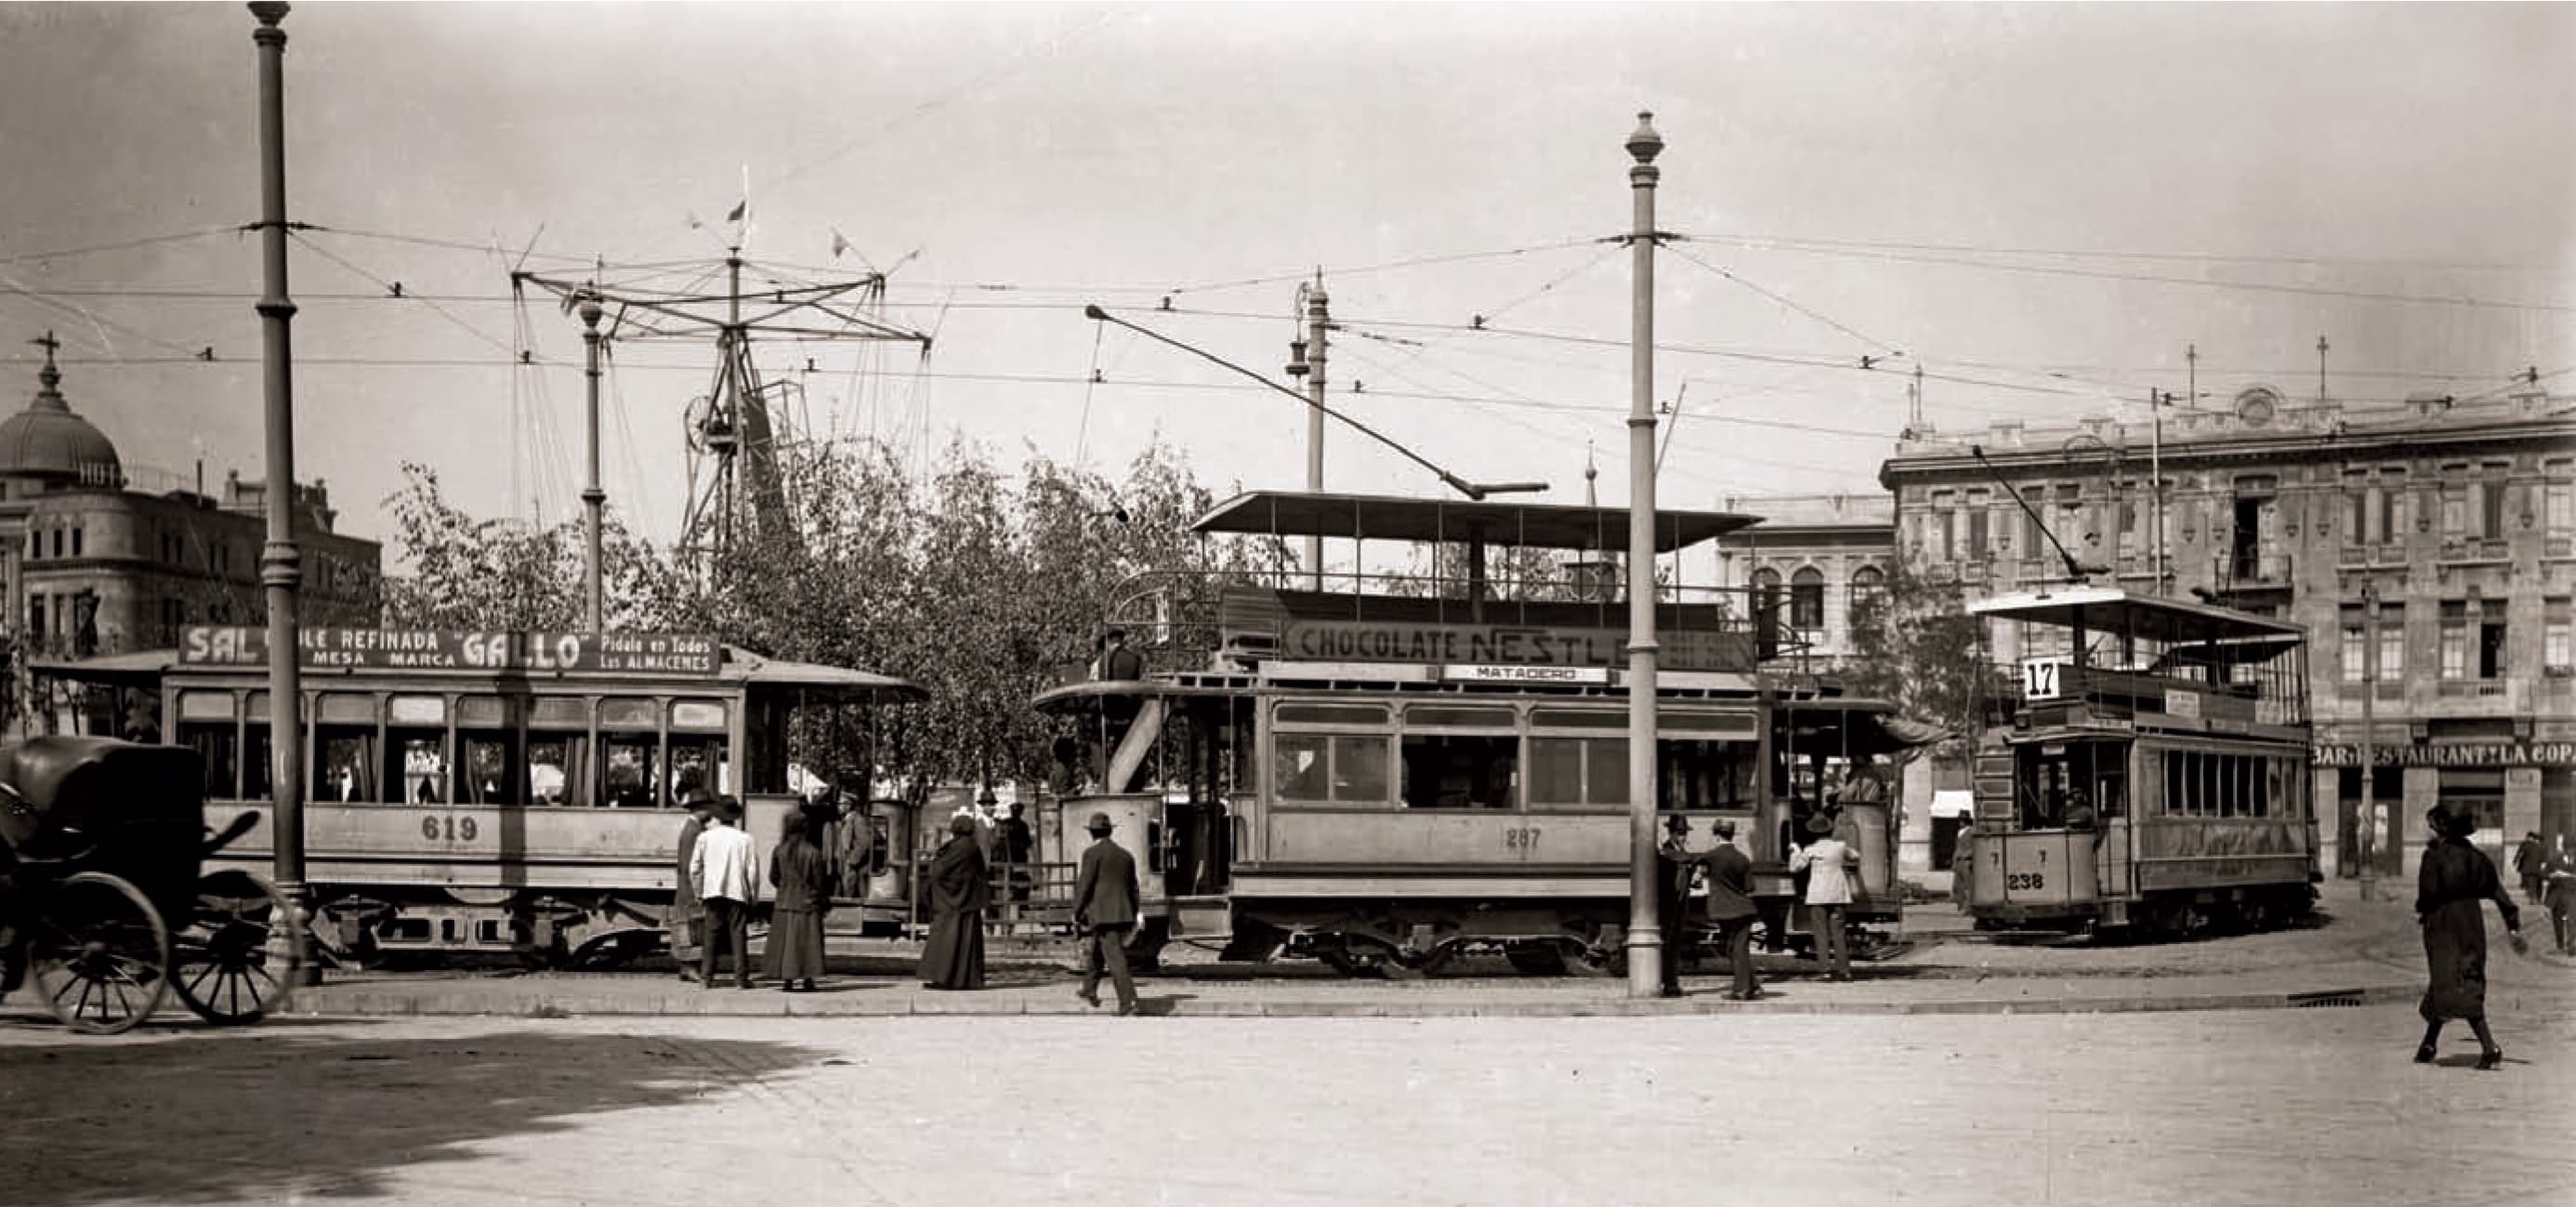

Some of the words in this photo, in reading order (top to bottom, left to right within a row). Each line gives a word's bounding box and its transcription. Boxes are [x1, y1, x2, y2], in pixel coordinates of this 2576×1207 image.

[187, 627, 257, 663] SAL
[342, 629, 439, 650] REFINADA
[651, 640, 666, 652] en
[671, 635, 710, 652] Todos
[1301, 627, 1457, 660] CHOCOLATE
[313, 651, 364, 665] MESA
[390, 653, 454, 667] MARCA
[1477, 667, 1577, 680] MATADERO
[2028, 663, 2055, 696] 17
[2500, 744, 2527, 765] LA
[2531, 743, 2576, 765] COP
[422, 815, 478, 842] 619
[2008, 873, 2044, 890] 238
